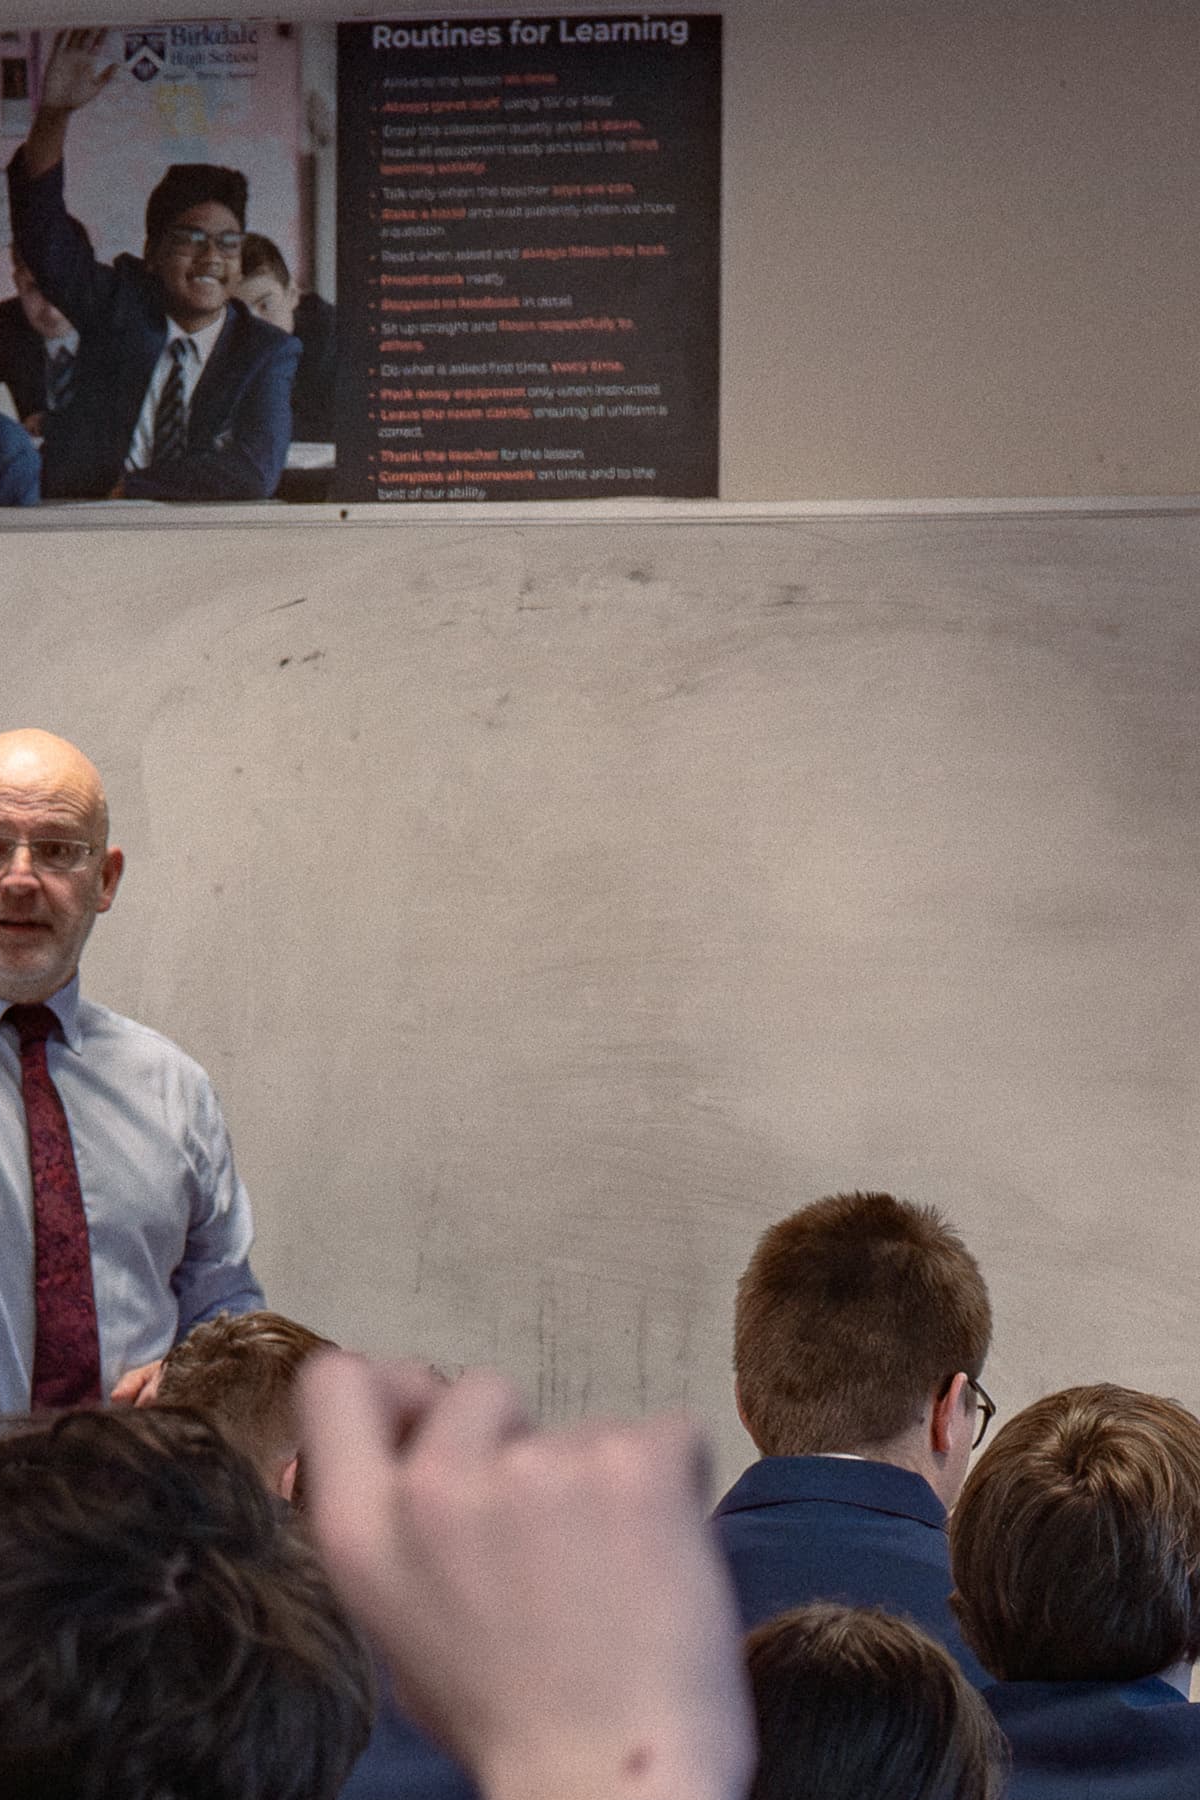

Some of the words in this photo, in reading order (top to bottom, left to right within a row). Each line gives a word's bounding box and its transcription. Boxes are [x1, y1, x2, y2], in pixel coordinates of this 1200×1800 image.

[170, 24, 259, 46] Birkdale
[372, 21, 502, 49] Routines
[510, 19, 550, 44] for
[559, 16, 689, 46] Learning
[402, 363, 435, 376] what
[448, 362, 487, 375] asked
[528, 385, 554, 400] only
[557, 384, 593, 397] when
[422, 408, 445, 420] the
[379, 449, 421, 462] Thank
[423, 449, 446, 462] the
[448, 447, 499, 462] teacher
[501, 447, 518, 460] for
[520, 447, 543, 460] the
[447, 469, 461, 482] all
[463, 468, 536, 482] homework
[538, 470, 555, 480] on
[556, 467, 588, 480] time
[589, 467, 616, 480] and
[633, 466, 656, 480] the
[377, 488, 405, 500] best
[408, 488, 422, 500] of
[424, 490, 446, 500] our
